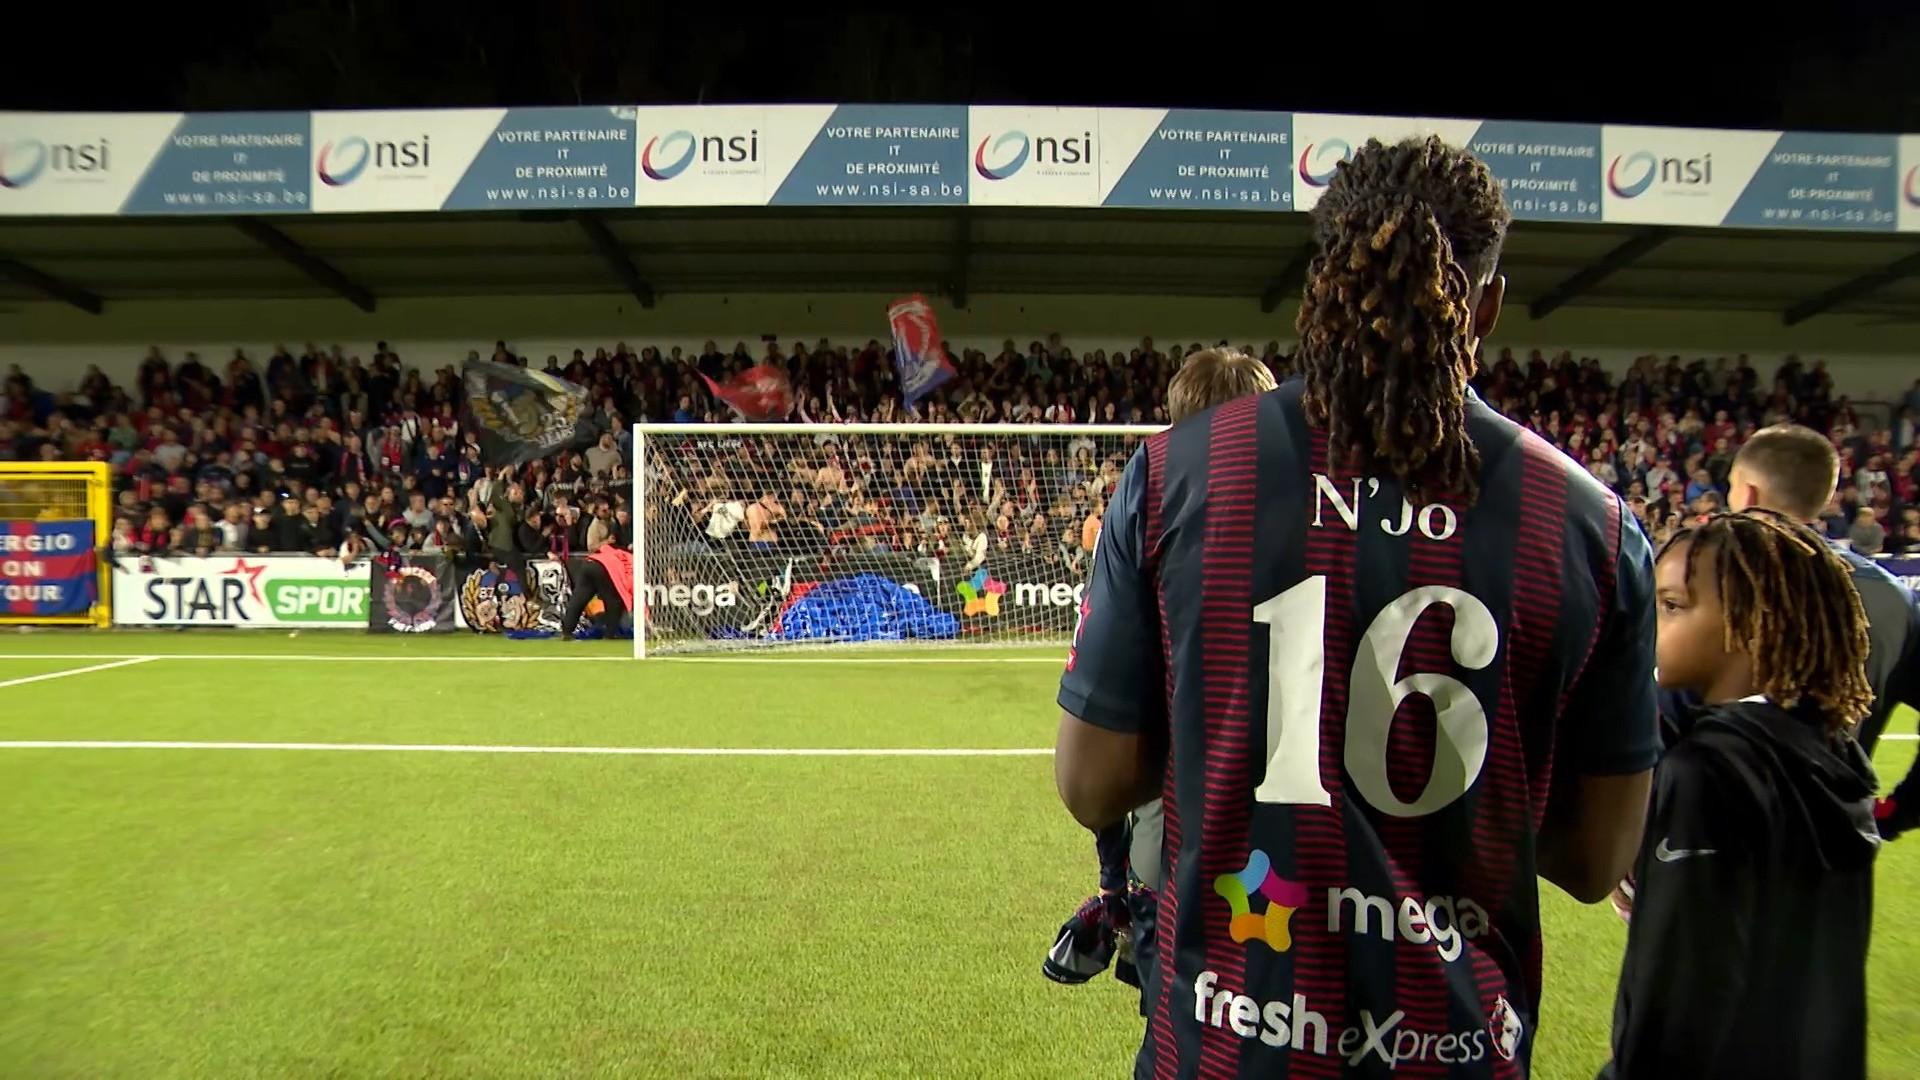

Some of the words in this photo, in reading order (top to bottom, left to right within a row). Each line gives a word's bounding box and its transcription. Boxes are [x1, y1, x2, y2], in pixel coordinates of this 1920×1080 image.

[497, 131, 541, 142] VOTRE
[545, 129, 627, 141] PARTENAIRE
[826, 127, 872, 138] VOTRE
[875, 126, 960, 138] PARTENAIRE
[1159, 129, 1203, 141] VOTRE
[1206, 131, 1288, 144] PARTENAIRE
[375, 135, 430, 168] nsi
[702, 129, 758, 163] nsi
[889, 145, 900, 156] IT
[1036, 131, 1091, 164] nsi
[1473, 143, 1514, 155] VOTRE
[1518, 144, 1595, 158] PARTENAIRE
[52, 137, 110, 172] nsi
[557, 148, 570, 160] IT
[1219, 149, 1231, 160] IT
[515, 167, 533, 178] DE
[537, 163, 608, 178] PROXIMITÉ
[846, 163, 864, 174] DE
[868, 161, 940, 174] PROXIMITÉ
[1178, 165, 1196, 176] DE
[1199, 165, 1269, 179] PROXIMITÉ
[1530, 162, 1542, 173] IT
[1660, 152, 1712, 185] nsi
[486, 185, 630, 200] www.nsi-sa.be
[816, 181, 963, 196] www.nsi-sa.be
[1496, 179, 1508, 190] E
[1511, 178, 1578, 192] PROXIMITÉ
[1149, 187, 1291, 202] www.nsi-sa.be
[2, 560, 46, 577] ON
[143, 577, 251, 621] STAR
[276, 586, 371, 615] SPOR
[644, 583, 737, 616] mega
[1253, 575, 1499, 818] 16
[1327, 887, 1489, 962] mega
[1194, 970, 1328, 1055] fresh
[1337, 1010, 1486, 1071] eXpress
